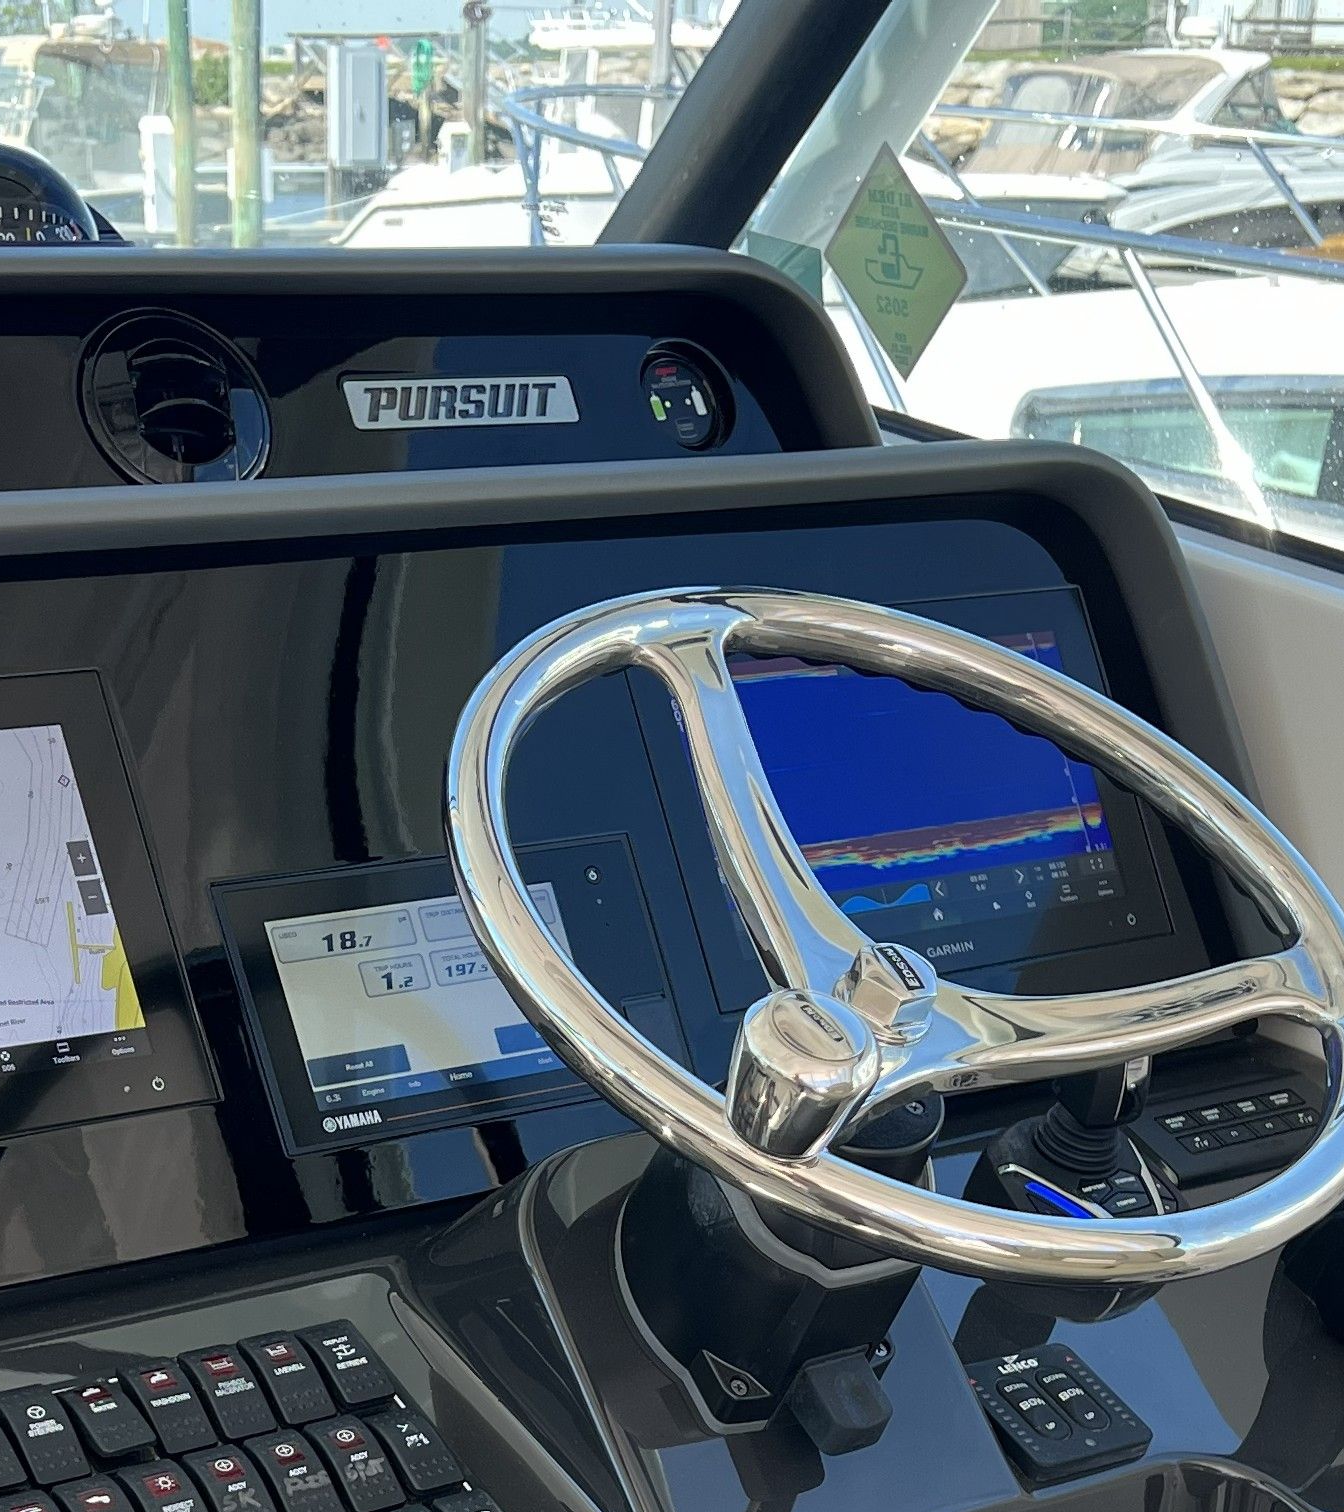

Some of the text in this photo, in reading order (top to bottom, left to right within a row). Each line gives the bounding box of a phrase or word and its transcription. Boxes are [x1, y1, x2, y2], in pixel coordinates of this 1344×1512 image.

[364, 382, 556, 423] PURSUIT
[321, 930, 373, 952] 18.7
[926, 940, 974, 958] GARMIN
[884, 947, 921, 988] EDSON
[380, 971, 414, 990] 1.2
[449, 1069, 473, 1082] Home
[362, 1086, 385, 1097] Engine
[334, 1109, 383, 1131] YAMAHA
[322, 1335, 348, 1347] DEPLOY
[273, 1362, 306, 1376] LIVEWELL
[336, 1356, 368, 1370] RETRIEVE
[997, 1358, 1039, 1374] LENCO
[1058, 1387, 1085, 1401] BOW
[1018, 1397, 1046, 1411] BOW
